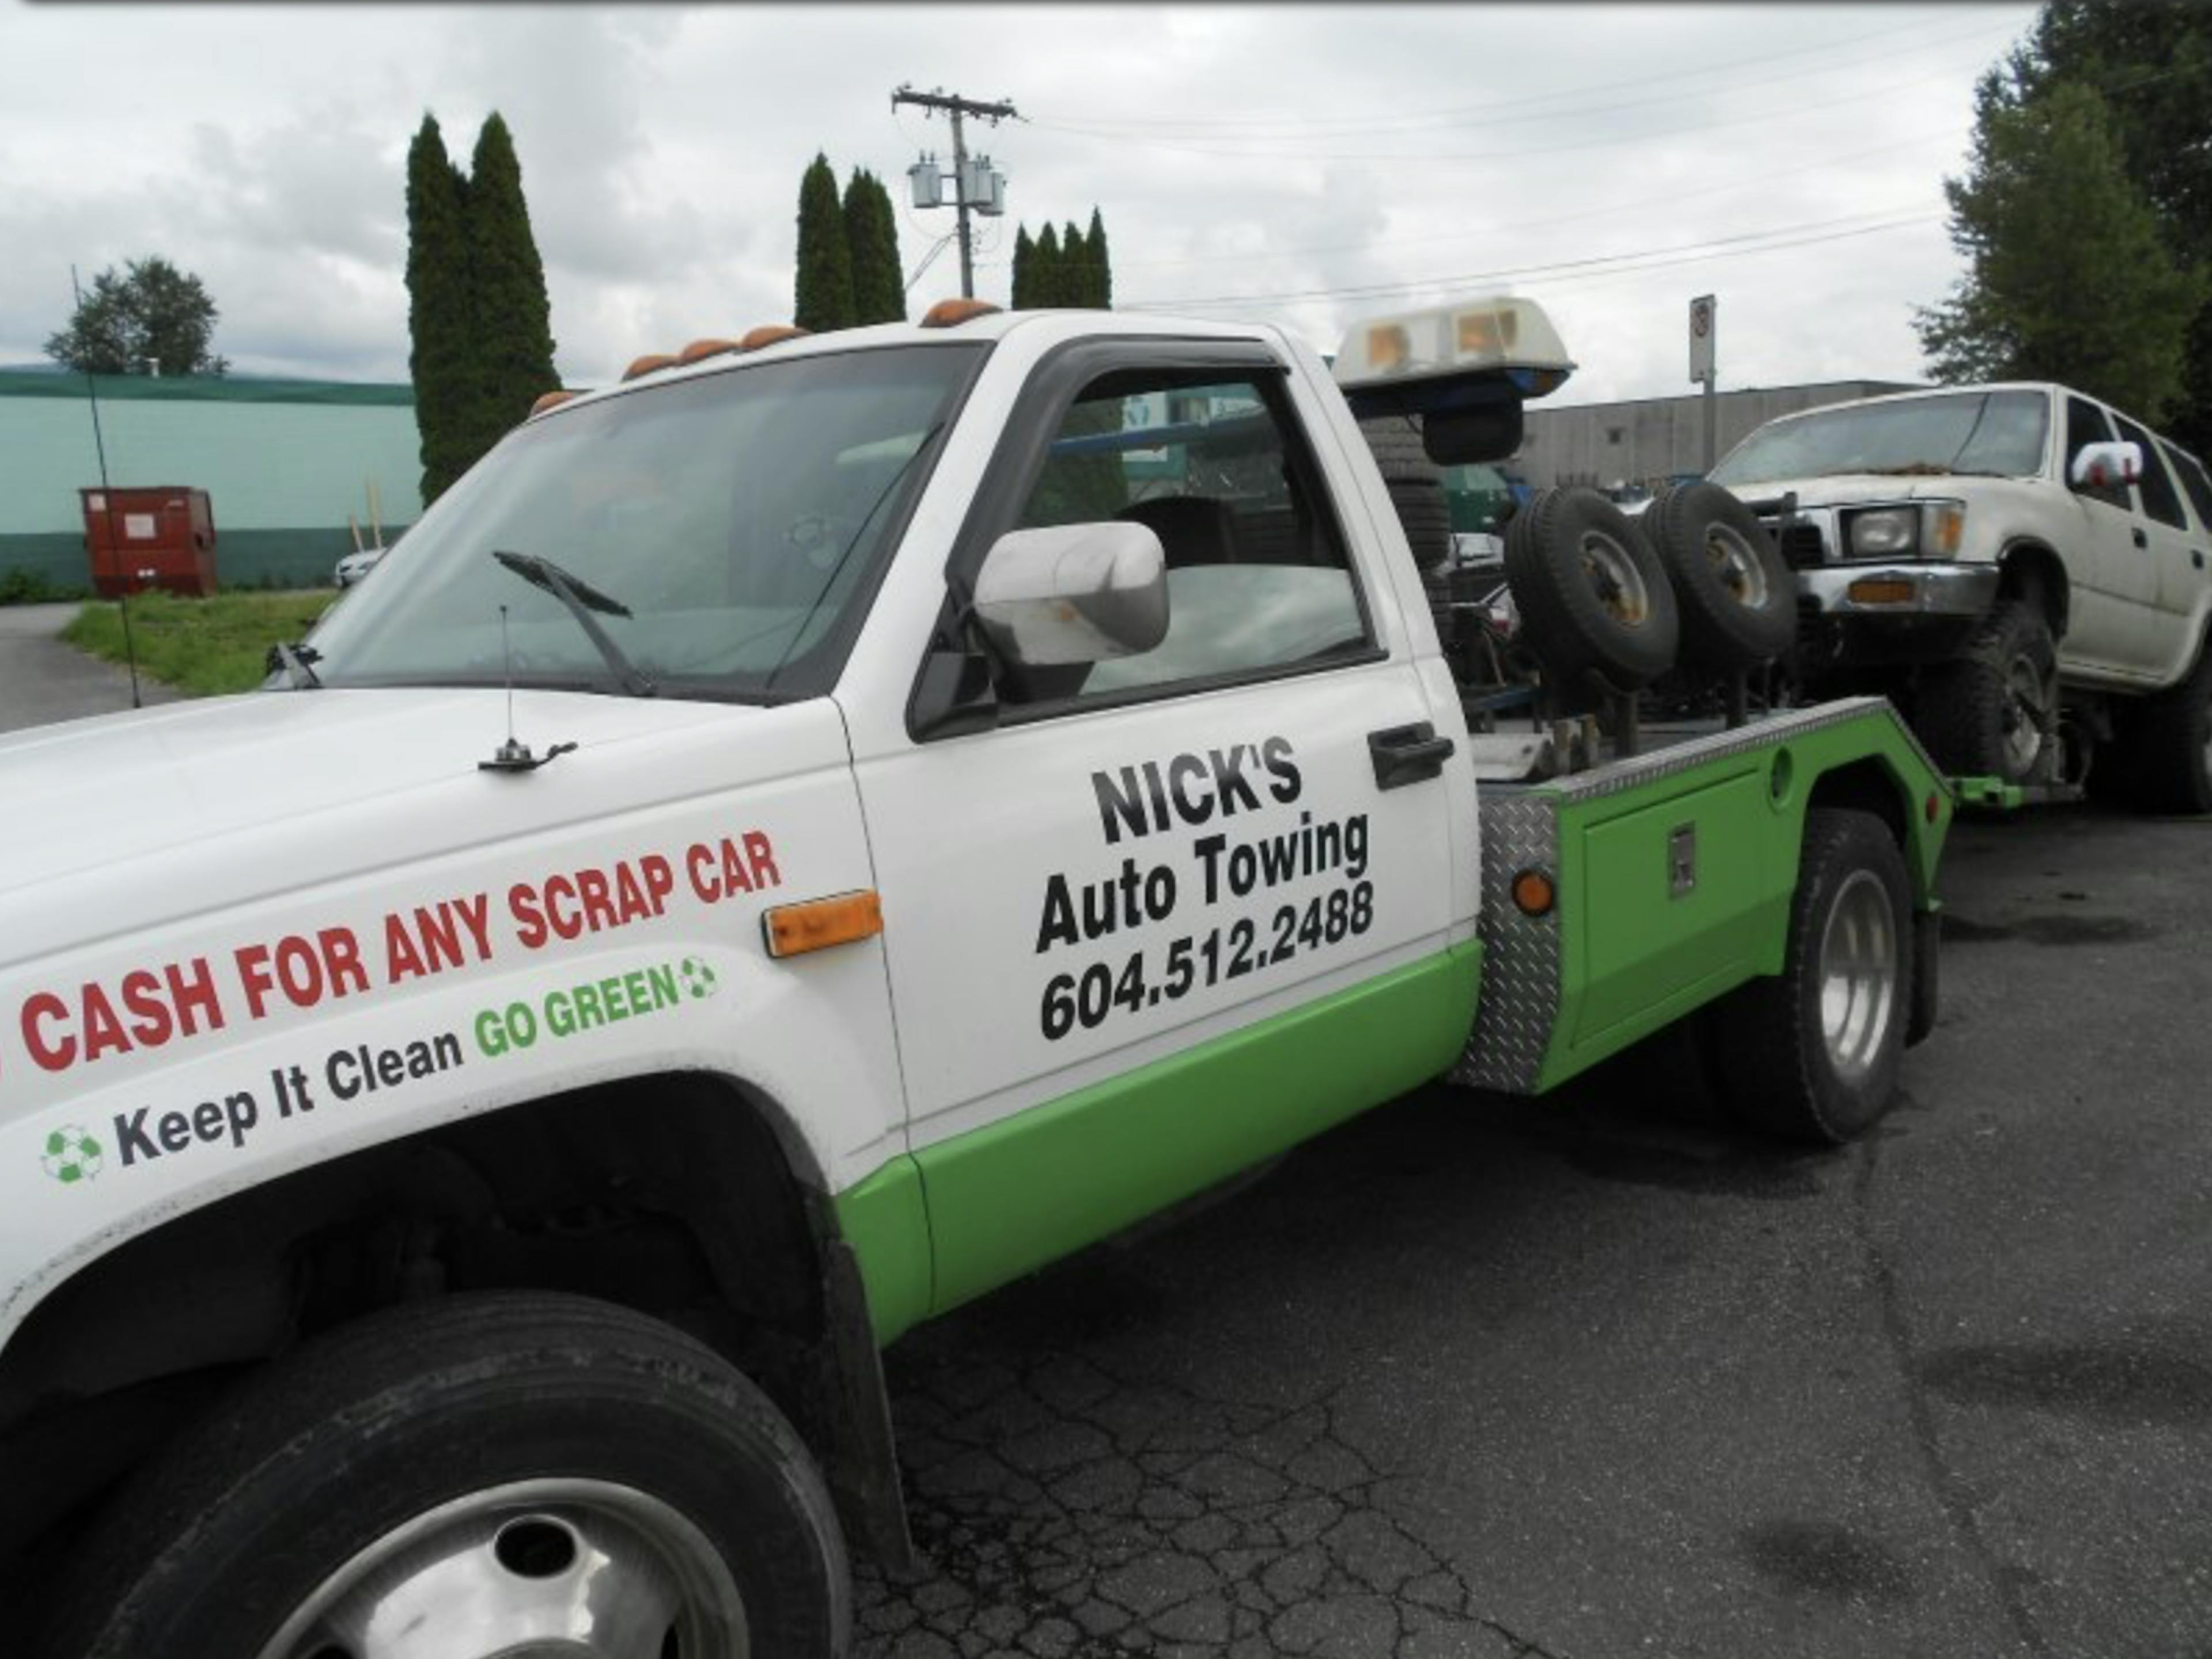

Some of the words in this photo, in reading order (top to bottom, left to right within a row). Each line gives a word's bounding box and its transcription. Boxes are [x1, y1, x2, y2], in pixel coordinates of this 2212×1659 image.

[1091, 736, 1301, 844] NICK'S
[21, 957, 225, 1072] CASH
[235, 926, 368, 1018] FOR
[385, 892, 494, 983] ANY
[507, 854, 675, 949] SCRAP
[686, 830, 781, 903] CAR
[1036, 858, 1176, 954] Auto
[1194, 810, 1369, 906] Towing
[1040, 880, 1374, 1041] 604.512.2488
[115, 1089, 257, 1166] Keep
[271, 1066, 315, 1118] It
[325, 1033, 464, 1101] Clean
[473, 999, 537, 1058] GO
[543, 963, 681, 1038] GREEN
